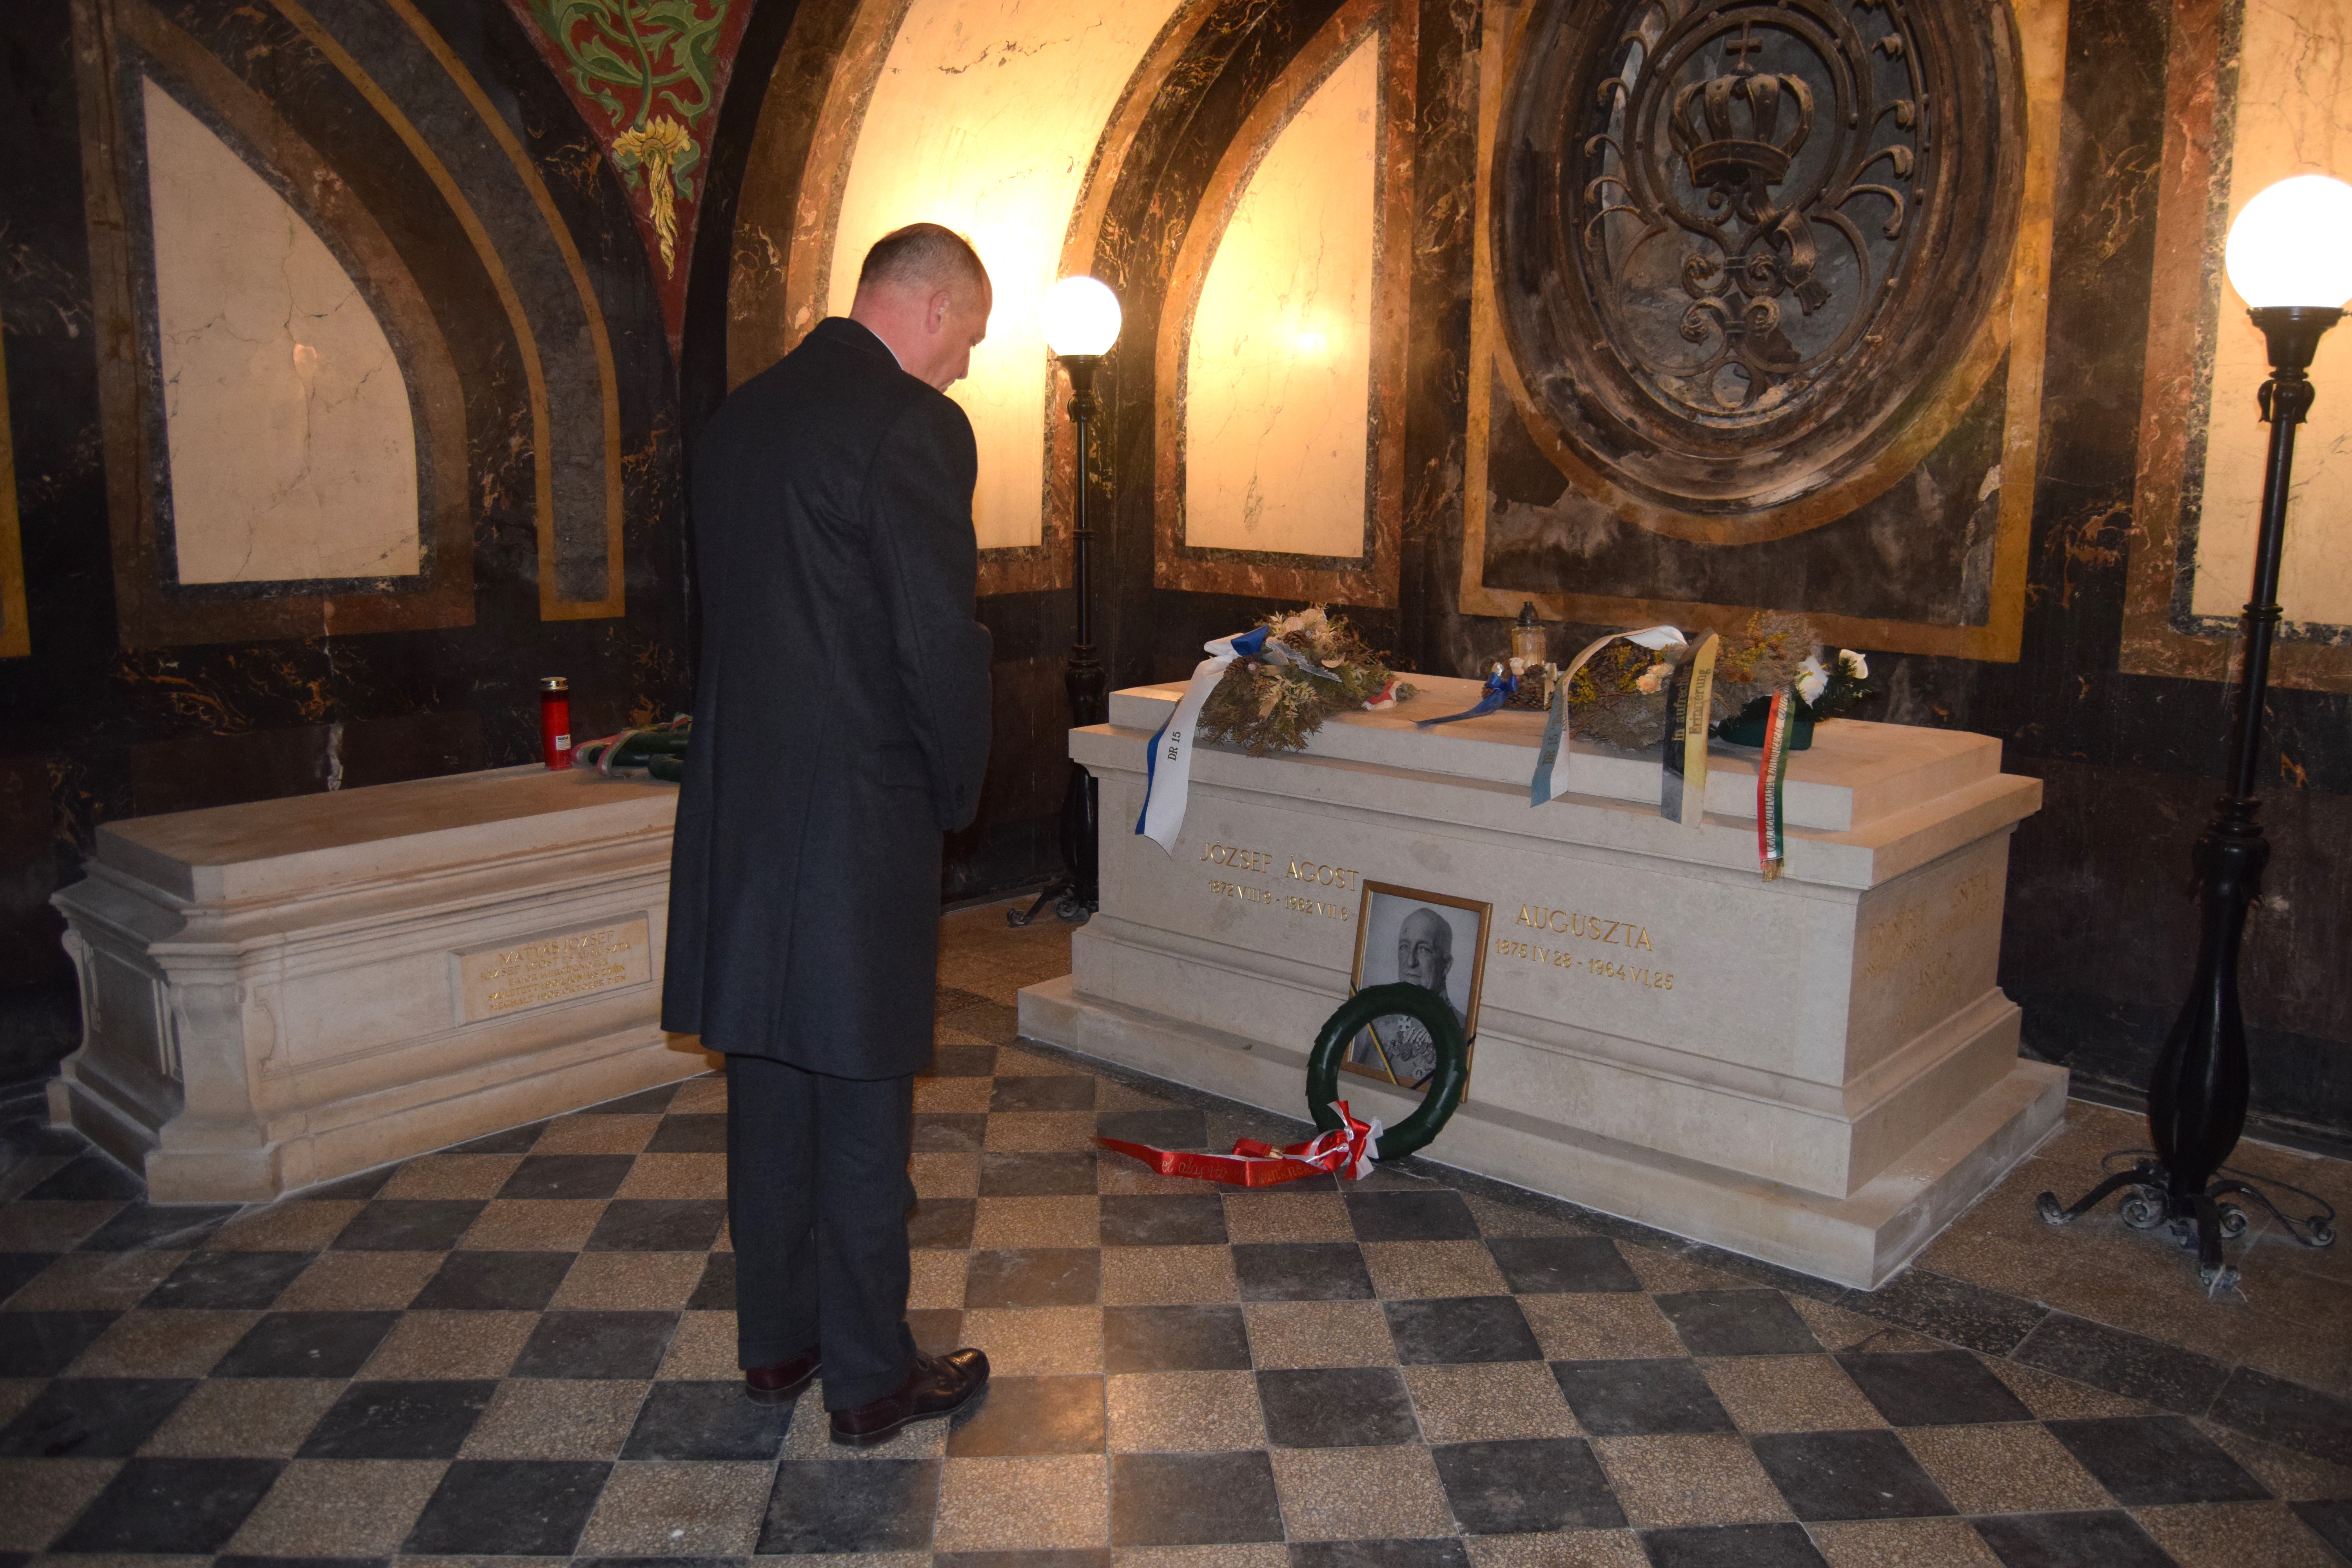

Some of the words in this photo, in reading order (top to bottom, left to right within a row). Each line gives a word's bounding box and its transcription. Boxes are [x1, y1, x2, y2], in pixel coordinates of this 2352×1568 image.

[1673, 665, 1691, 723] aufrechter
[1689, 669, 1711, 734] Erinnerung
[1167, 746, 1178, 761] DR
[1171, 731, 1181, 744] 15
[1671, 728, 1684, 741] In
[1200, 840, 1272, 873] JÓZSEF
[1285, 854, 1359, 891] ÁGOST
[1209, 880, 1234, 897] 1872
[1285, 895, 1313, 914] 1962
[564, 931, 614, 952] JÓZSEF
[1515, 904, 1653, 952] AUGUSZTA
[1495, 938, 1528, 959] 1875
[1588, 958, 1626, 980] 1964
